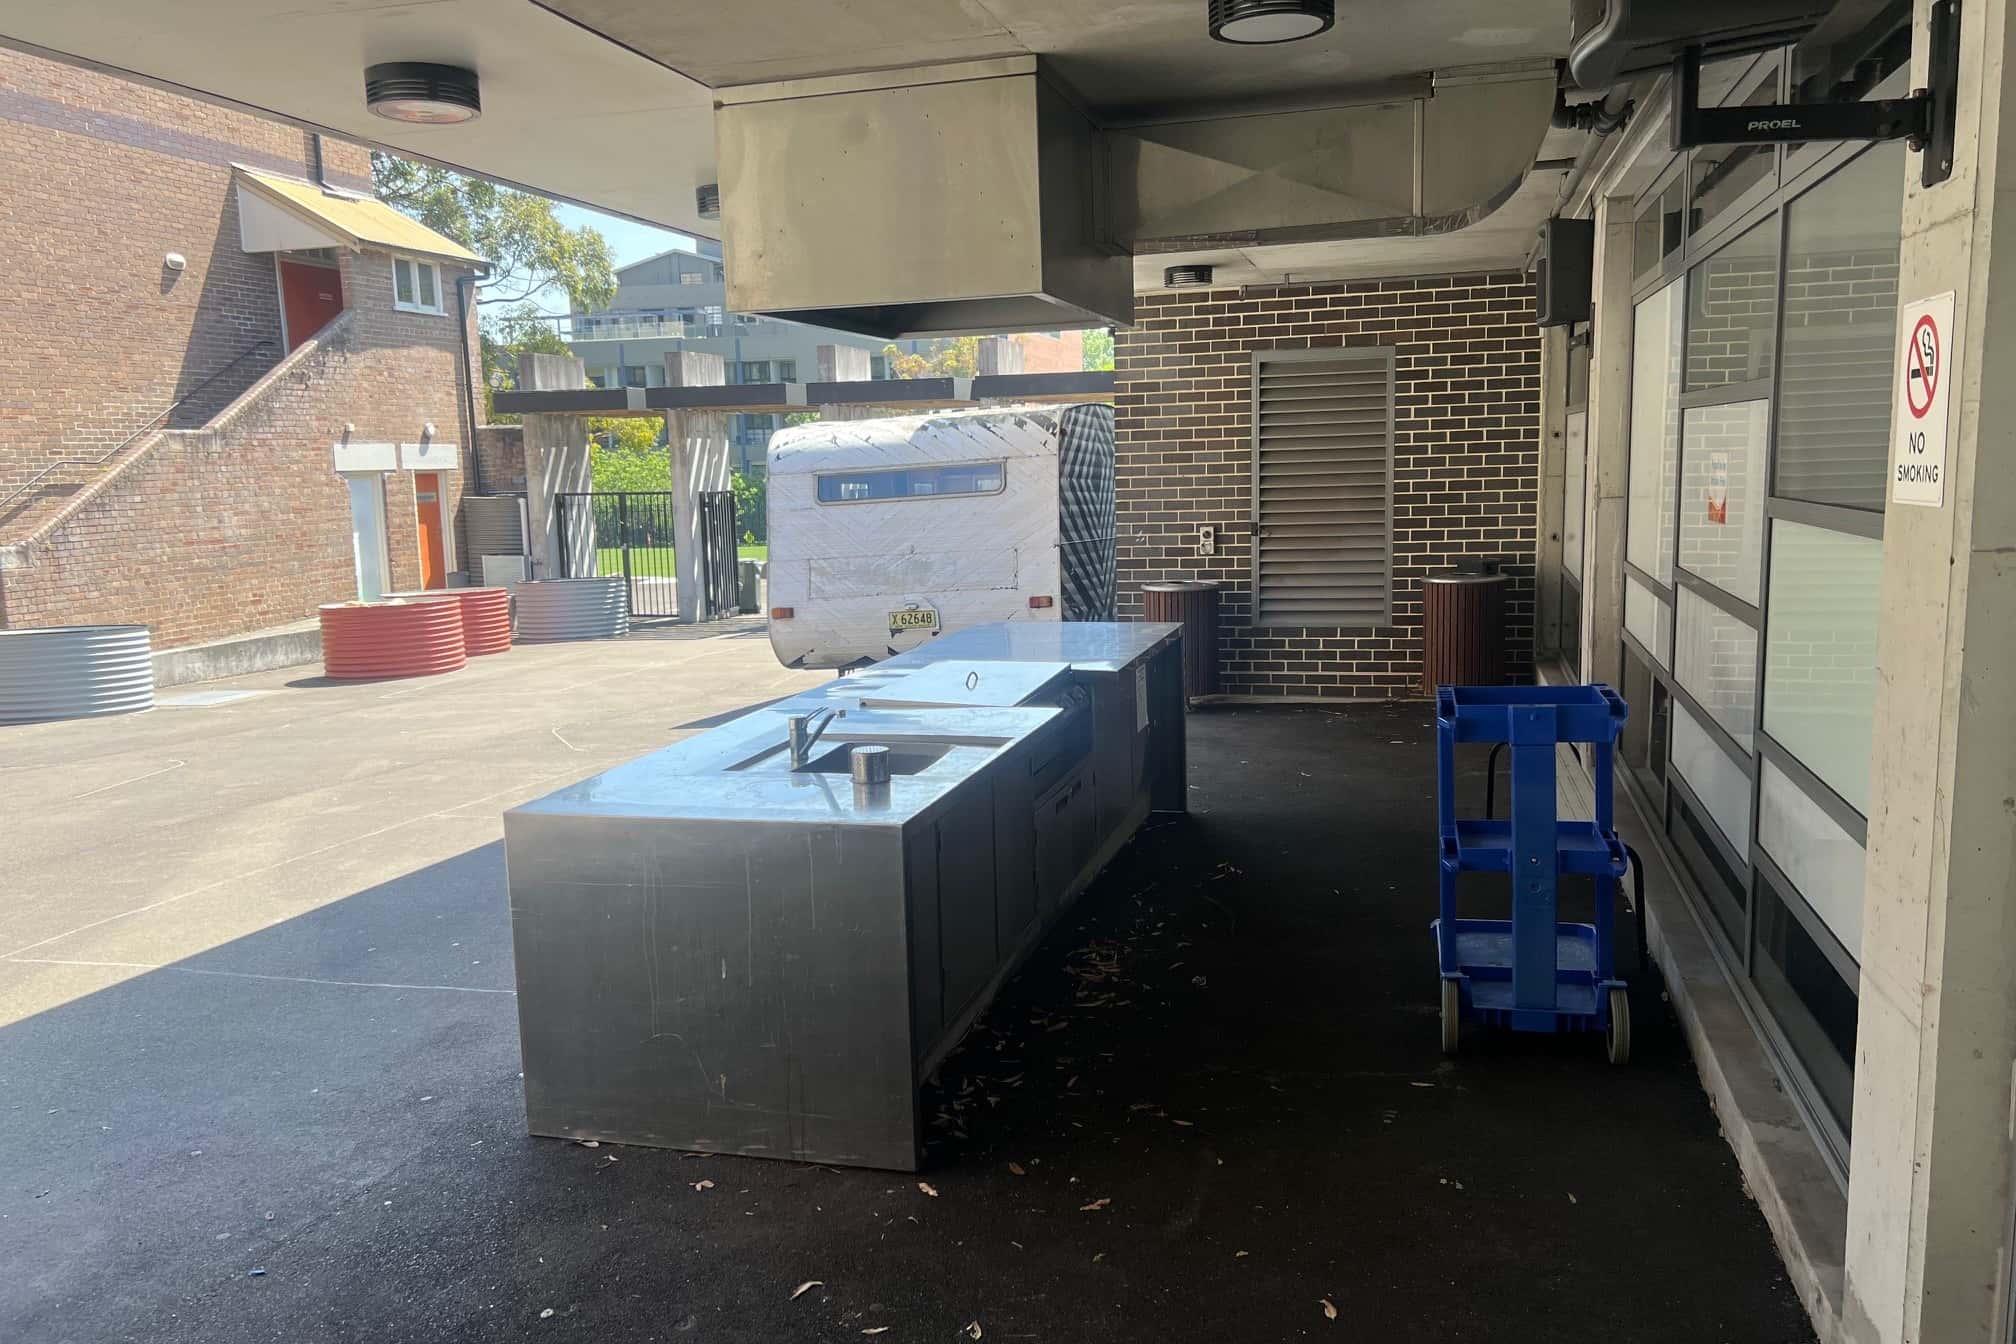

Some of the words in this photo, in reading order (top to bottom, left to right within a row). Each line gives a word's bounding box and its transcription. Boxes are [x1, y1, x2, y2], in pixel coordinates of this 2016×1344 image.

[1748, 119, 1801, 130] PROEL
[1909, 431, 1926, 454] NO
[1897, 464, 1939, 483] SMOKING
[892, 613, 898, 625] X
